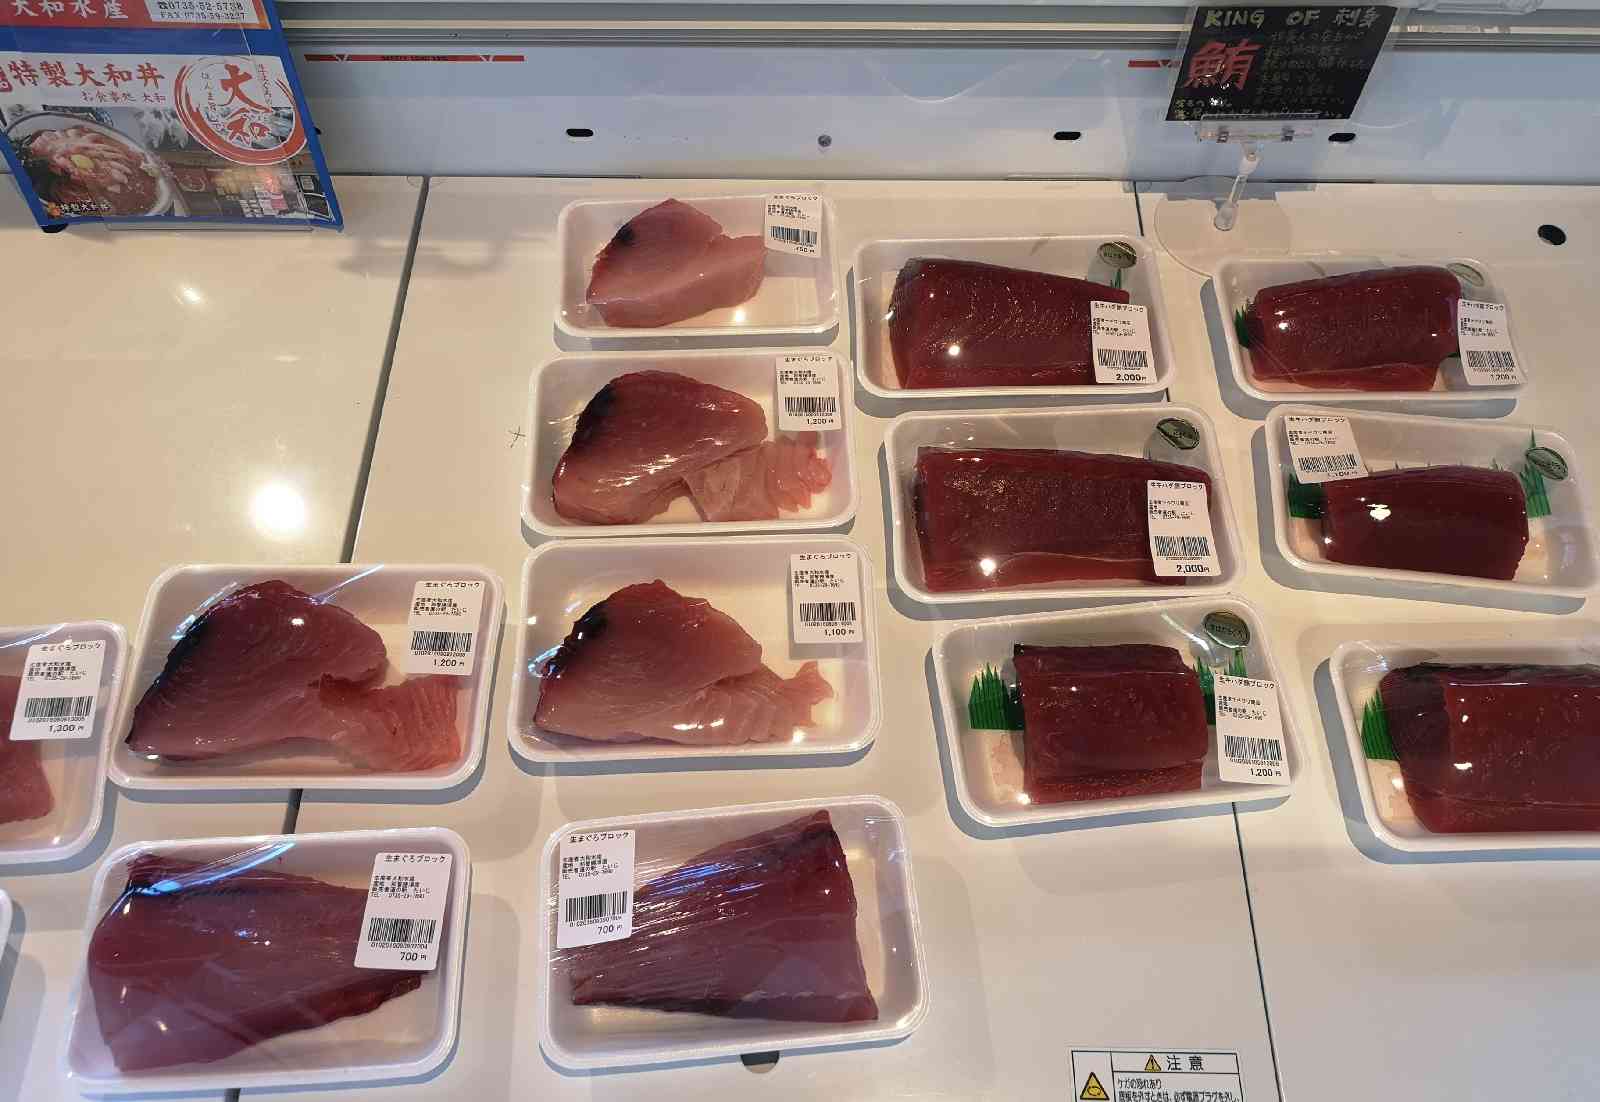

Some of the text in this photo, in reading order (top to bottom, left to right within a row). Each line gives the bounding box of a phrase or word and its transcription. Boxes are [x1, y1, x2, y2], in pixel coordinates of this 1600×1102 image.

[11, 0, 129, 18] 大和水産
[1204, 9, 1264, 29] KING
[1286, 9, 1321, 27] OF
[8, 60, 165, 89] 特製大和丼
[1184, 38, 1265, 91] 鮪
